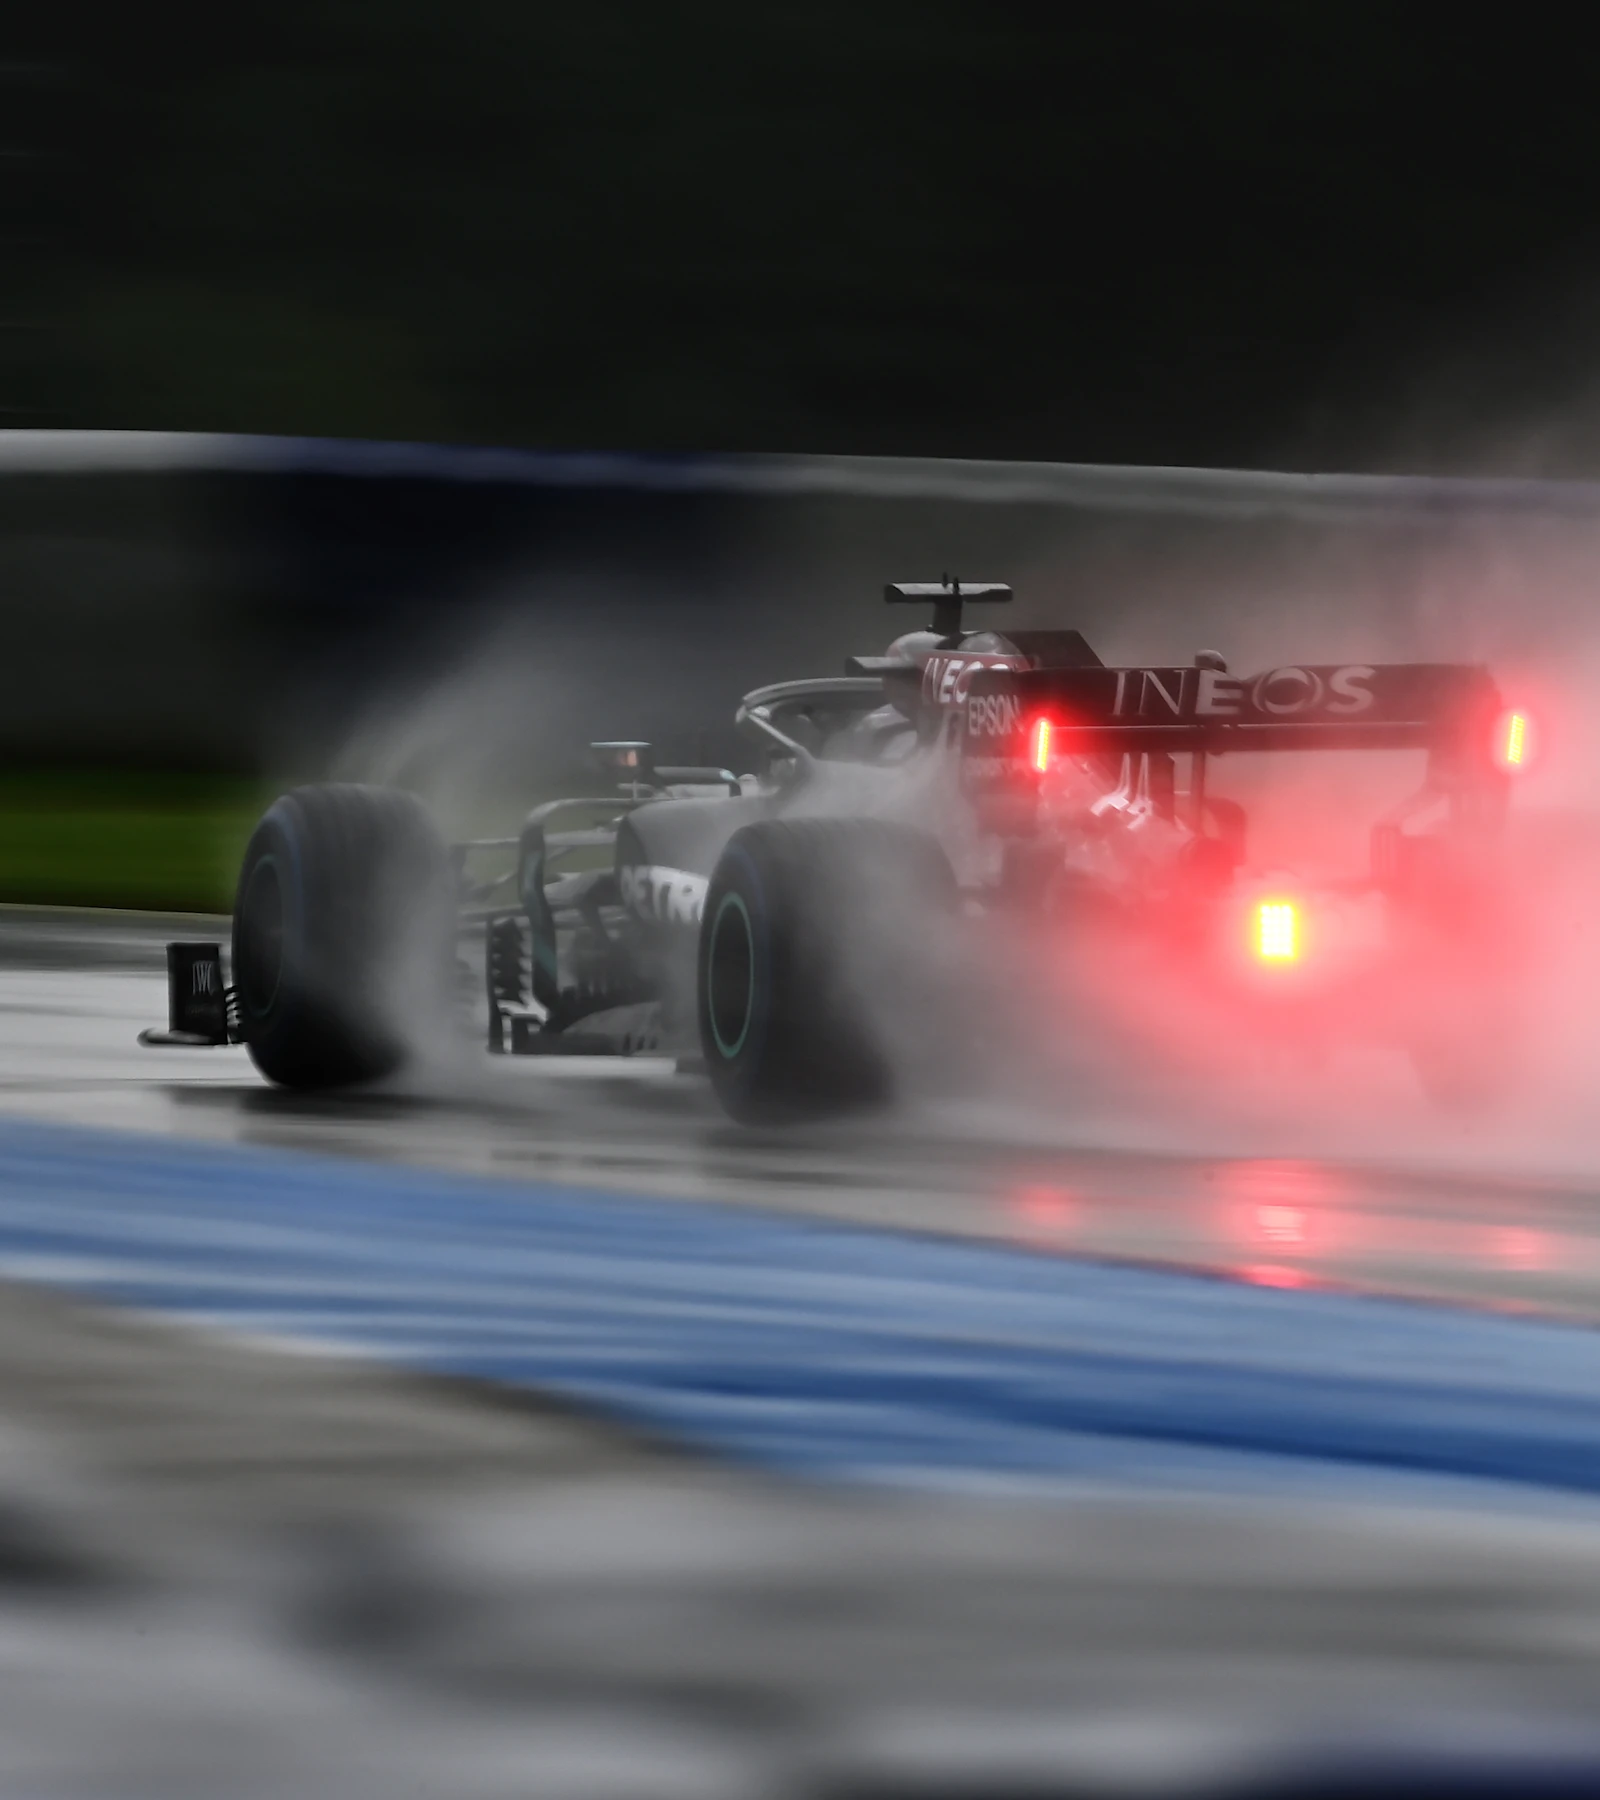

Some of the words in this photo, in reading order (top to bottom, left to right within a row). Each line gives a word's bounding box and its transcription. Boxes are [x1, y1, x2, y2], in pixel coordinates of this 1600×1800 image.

[922, 658, 1009, 704] INEO
[1109, 667, 1376, 716] INEOS
[968, 694, 1024, 737] EPSON
[621, 865, 708, 925] PETR
